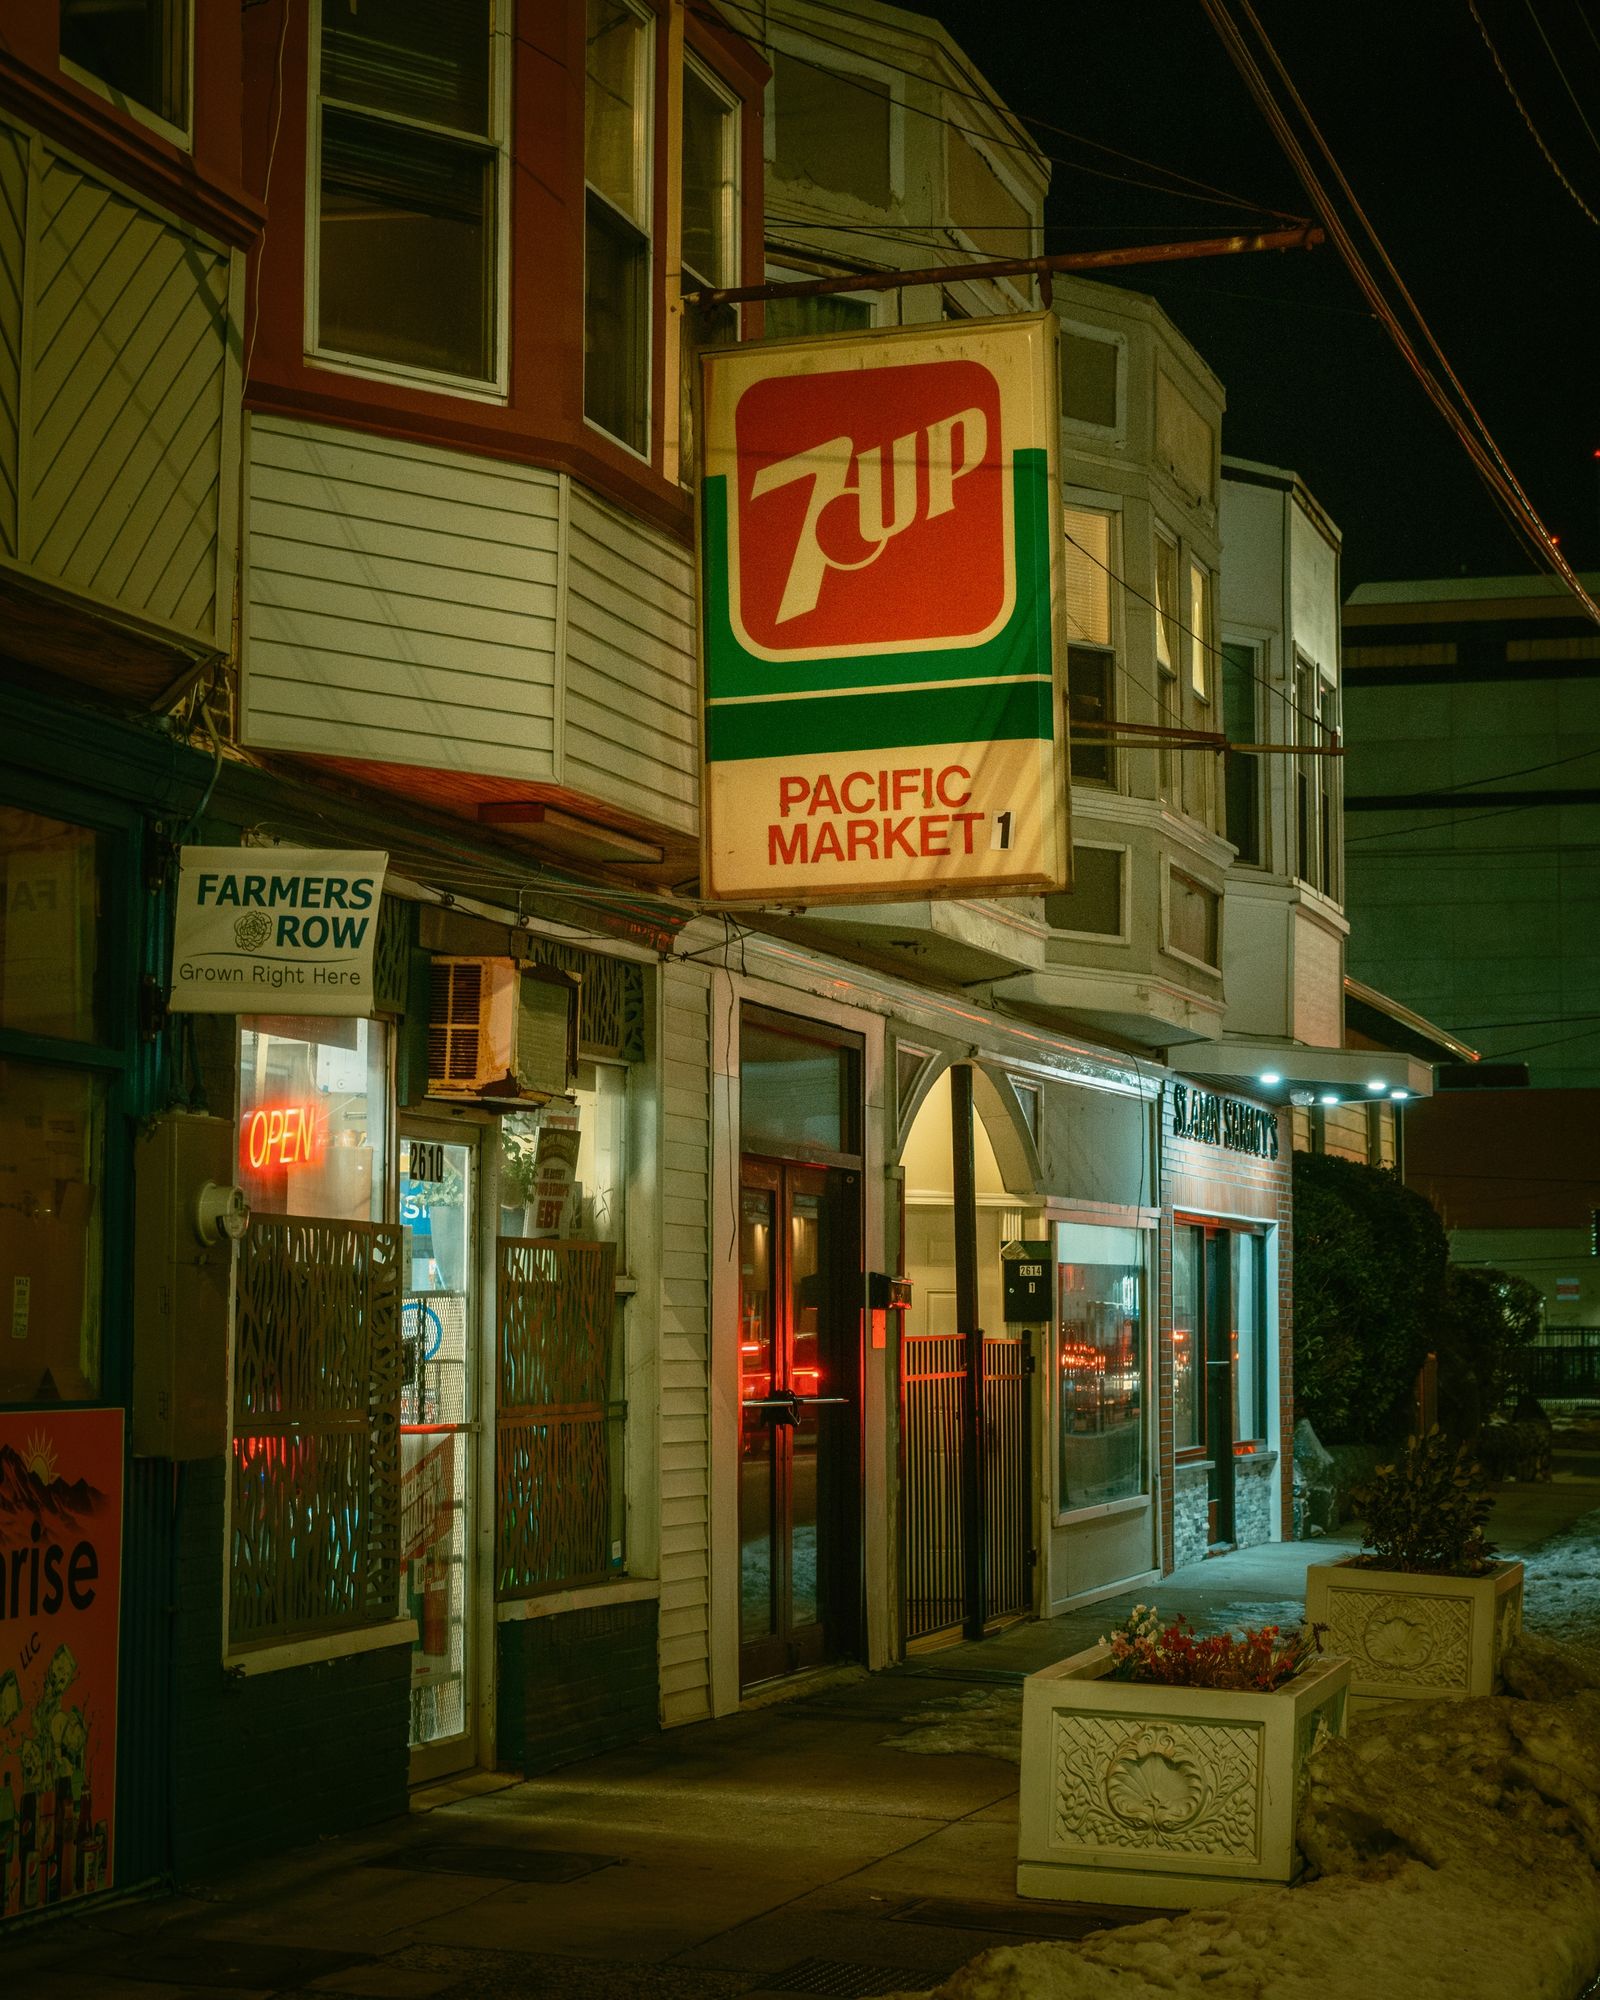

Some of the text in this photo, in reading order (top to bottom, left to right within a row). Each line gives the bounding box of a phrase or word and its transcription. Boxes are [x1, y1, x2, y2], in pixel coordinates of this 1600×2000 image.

[779, 765, 971, 817] PACIFIC
[768, 812, 984, 866] MARKET
[997, 812, 1013, 850] 1
[197, 874, 375, 910] FARMERS
[276, 915, 369, 949] ROW
[180, 963, 361, 988] Grown Right Here
[249, 1107, 315, 1168] OPEN
[410, 1143, 443, 1182] 2610
[1020, 1266, 1042, 1276] 2614
[20, 1632, 41, 1670] LLC
